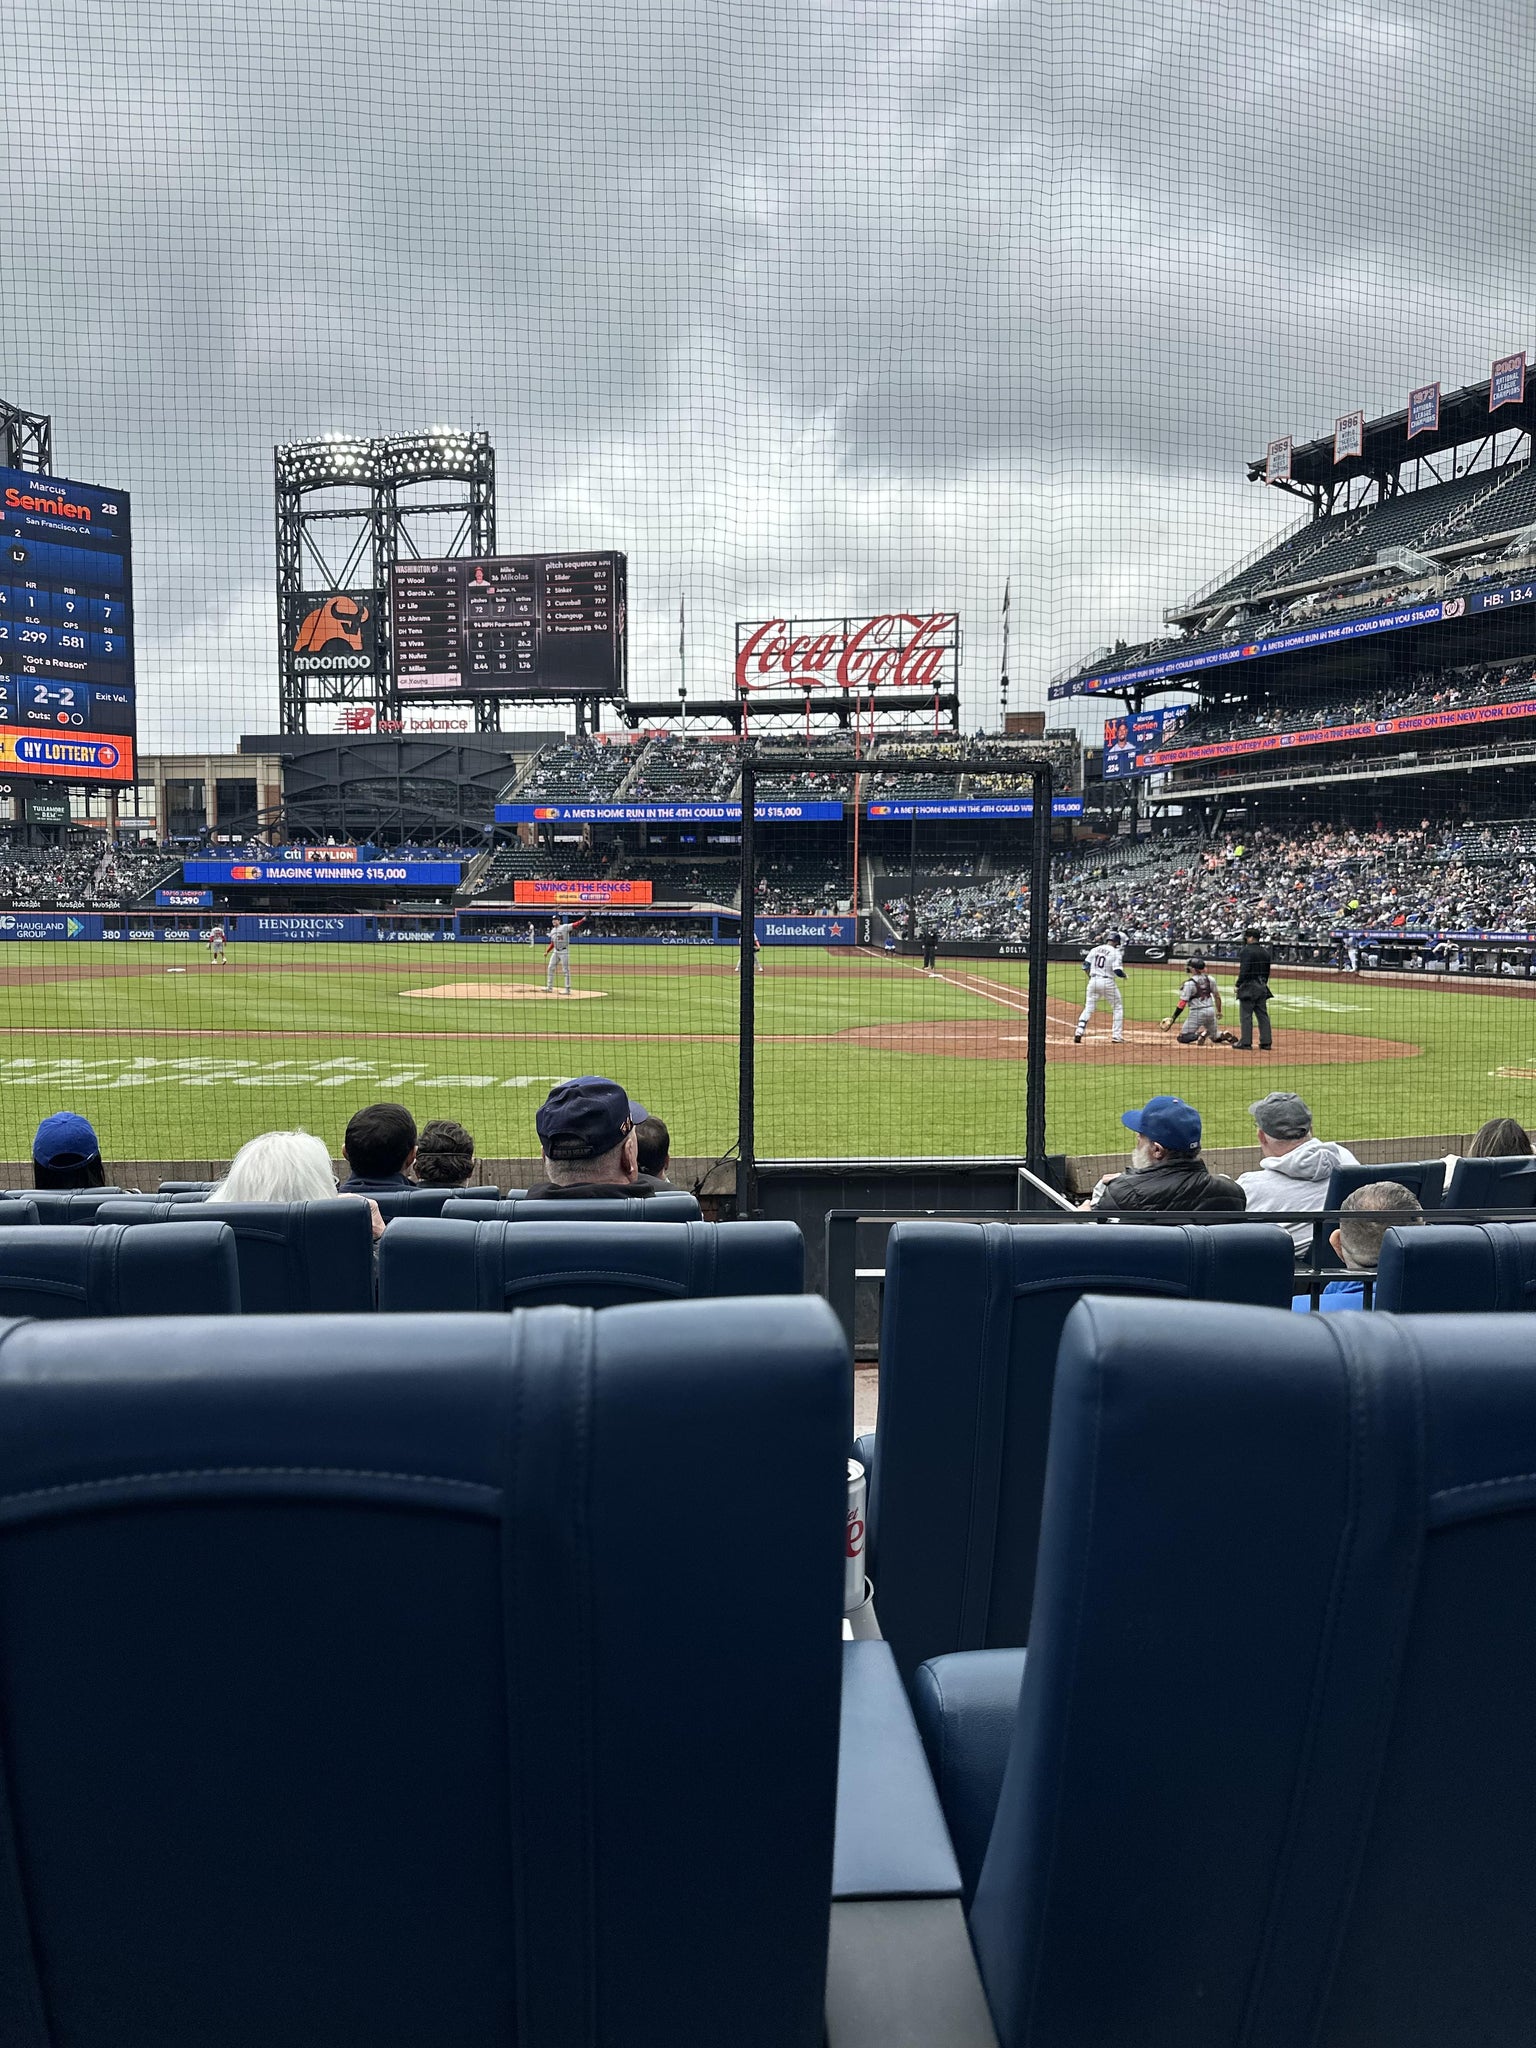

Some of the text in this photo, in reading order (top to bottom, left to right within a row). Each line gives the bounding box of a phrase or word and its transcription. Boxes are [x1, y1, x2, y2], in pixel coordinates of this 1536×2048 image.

[1495, 357, 1522, 377] 2000
[1497, 380, 1517, 392] LEAGUE
[1413, 388, 1435, 405] 1973
[1493, 386, 1520, 401] CHAMPIONS
[1339, 416, 1358, 431] 1986
[1271, 441, 1288, 455] 1969
[29, 481, 67, 496] Marcus
[5, 488, 92, 521] Semien
[101, 503, 118, 515] 2B
[26, 517, 91, 535] San Francisco, CA
[395, 565, 431, 574] WASHINGTON
[545, 562, 564, 571] pitch
[564, 561, 597, 569] sequence
[500, 573, 529, 581] Mikolas
[25, 581, 37, 589] HR
[63, 587, 76, 595] RBI
[28, 596, 34, 607] 1
[554, 599, 581, 607] Curveball
[1483, 587, 1533, 608] HB: 13.4
[65, 602, 75, 613] 9
[103, 607, 112, 618] 7
[25, 616, 40, 624] SLG
[554, 612, 583, 620] Changeup
[63, 621, 79, 630] OPS
[1268, 640, 1284, 650] METS
[1285, 636, 1305, 647] HOME
[1305, 633, 1319, 643] RUN
[1319, 631, 1327, 640] IN
[1327, 628, 1340, 638] THE
[1340, 625, 1354, 635] 4TH
[1354, 620, 1378, 632] COULD
[1379, 616, 1394, 627] WIN
[1394, 613, 1410, 624] YOU
[1411, 607, 1440, 622] $15,000
[18, 630, 47, 644] .299
[58, 635, 85, 649] .581
[104, 641, 113, 652] 3
[22, 655, 44, 666] "Got
[52, 659, 88, 670] Reason"
[294, 655, 371, 671] moomoo
[23, 665, 36, 674] KB
[33, 684, 75, 707] 2-2
[95, 692, 128, 703] Exit Vel.
[27, 711, 51, 720] Outs:
[1163, 711, 1174, 719] Bot
[1398, 708, 1503, 729] ENTER ON THE NEW YORK
[378, 717, 468, 731] new balance
[1132, 721, 1158, 732] Semien
[1299, 732, 1323, 742] SWING
[1330, 729, 1343, 738] THE
[1344, 726, 1371, 736] FENCES
[23, 741, 42, 758] NY
[45, 743, 96, 763] LOTTERY
[32, 805, 65, 813] TULLAMORE
[563, 807, 802, 818] A METS HOME RUN IN THE 4TH COULD $15,000
[996, 804, 1020, 812] COULD
[1053, 803, 1081, 812] $15,000
[307, 850, 354, 859] PVLION
[266, 867, 407, 880] IMAGINE WINNING $15,000
[535, 883, 631, 892] SWING 4 THE FENCES
[12, 900, 40, 909] HubSpot
[56, 900, 85, 909] HubSpot
[92, 900, 121, 909] HubSpot
[169, 896, 200, 905] $3,290
[16, 922, 64, 930] HAUGLAND
[258, 918, 344, 929] HENDRICK'S
[16, 930, 46, 938] GROUP
[102, 931, 120, 939] 380
[766, 923, 825, 936] Heineken
[442, 932, 455, 941] 370
[1005, 946, 1027, 954] DELTA
[1095, 955, 1106, 969] 10
